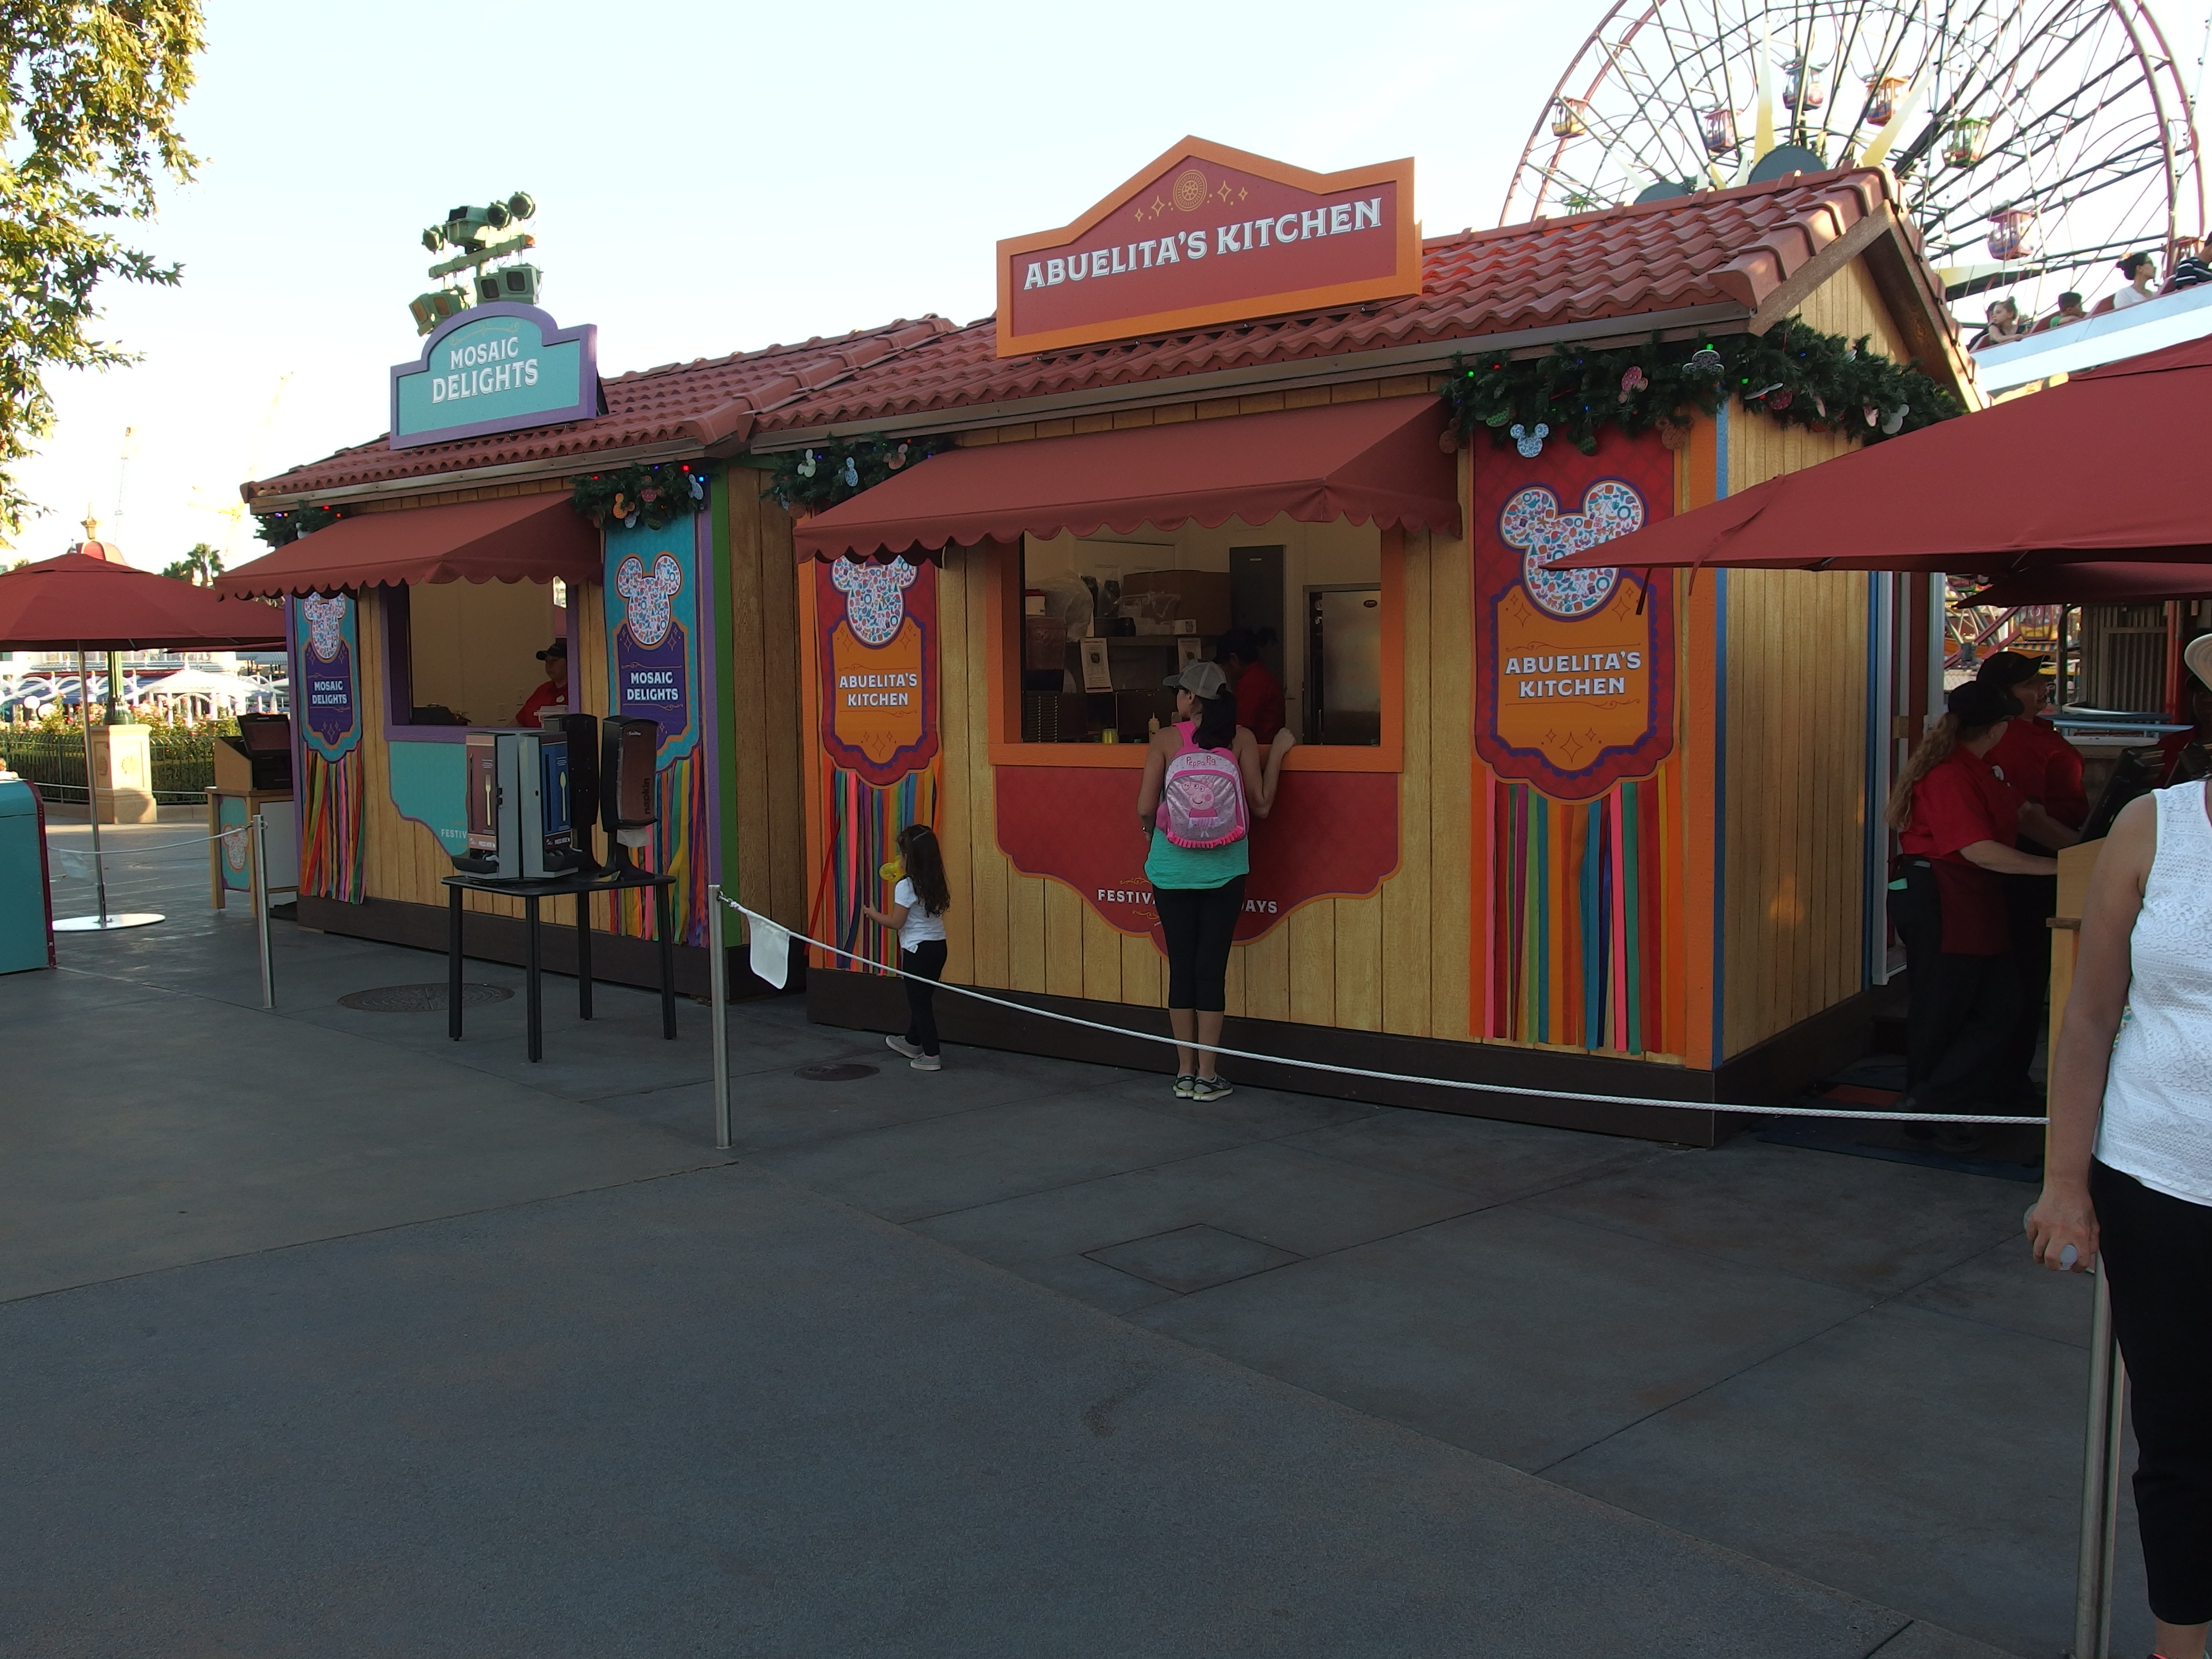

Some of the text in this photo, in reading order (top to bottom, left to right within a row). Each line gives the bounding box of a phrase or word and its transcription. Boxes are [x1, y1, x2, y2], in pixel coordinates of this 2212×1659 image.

[1023, 197, 1382, 290] ABUELITA'S KITCHEN
[449, 336, 519, 371] MOSAIC
[432, 358, 539, 404] DELIGHTS
[1505, 651, 1642, 675] ABUELITA'S
[314, 680, 343, 691] MOSAIC
[630, 671, 673, 685] MOSAIC
[839, 672, 918, 688] ABUELITA'S
[627, 688, 679, 701] DELIGHTS
[1519, 677, 1626, 698] KITCHEN
[312, 693, 348, 705] DELIGHTS
[847, 692, 909, 707] KITCHEN
[1186, 755, 1216, 768] Peppa Pig
[642, 777, 651, 814] napkin
[441, 828, 467, 839] FESTIV
[1097, 889, 1278, 914] FESTIV AYS
